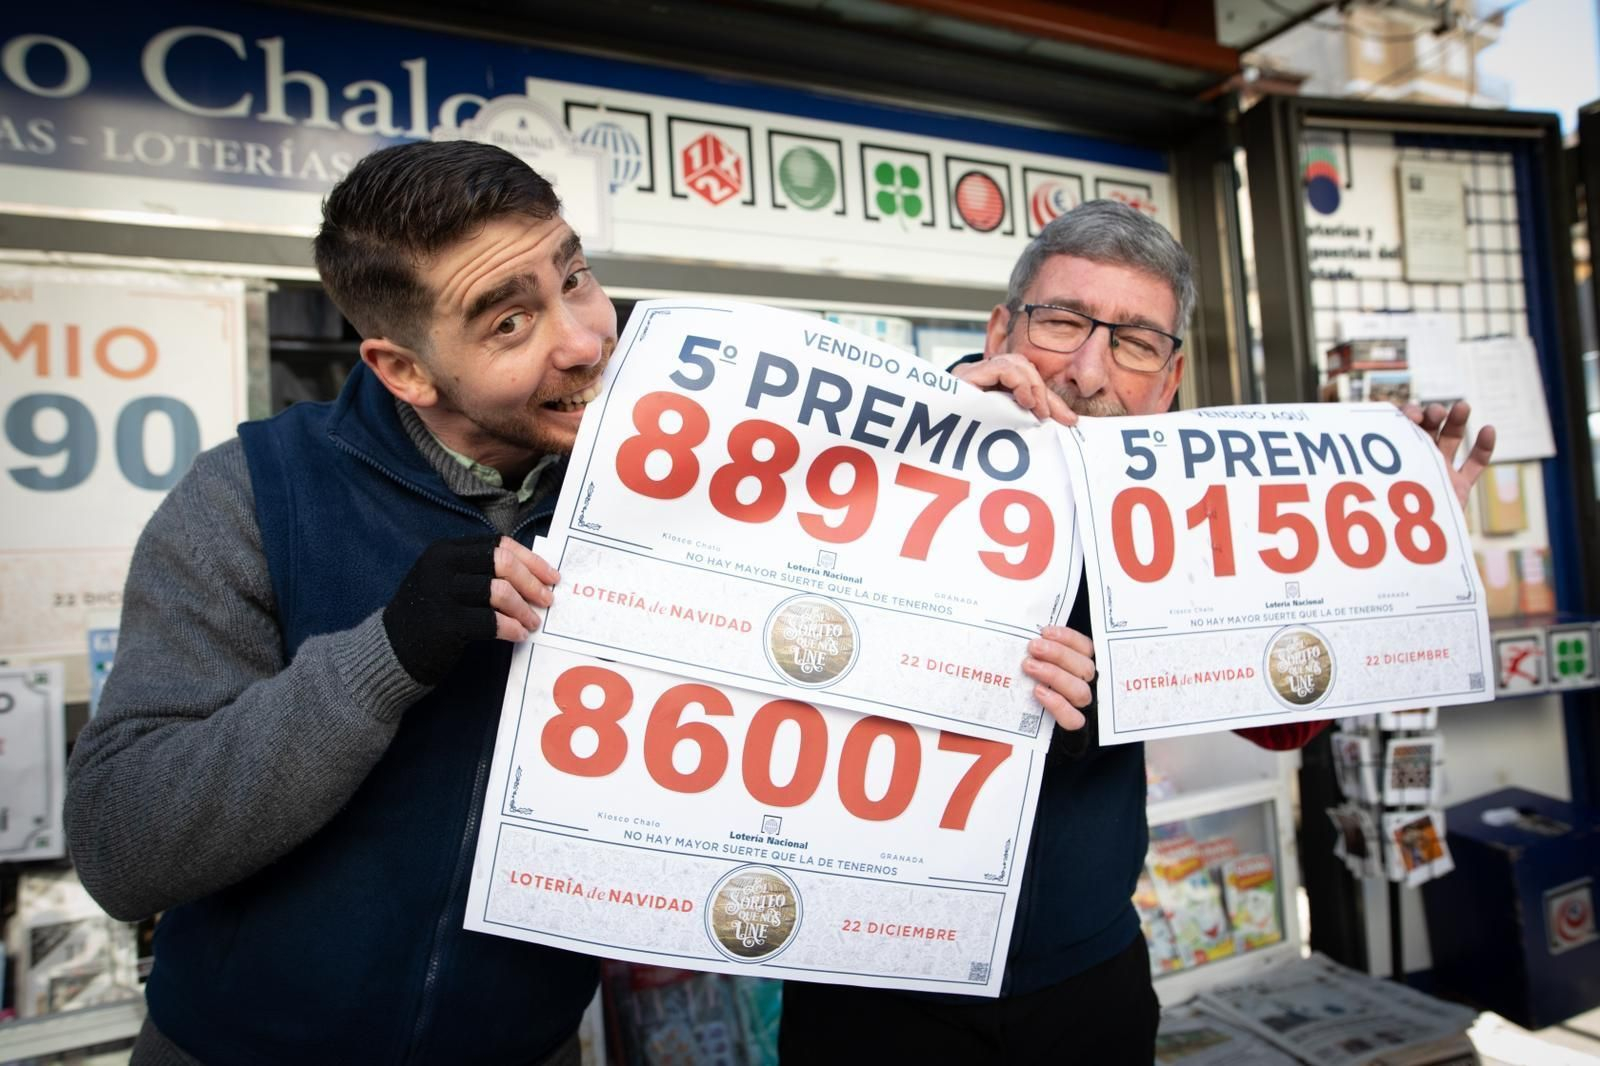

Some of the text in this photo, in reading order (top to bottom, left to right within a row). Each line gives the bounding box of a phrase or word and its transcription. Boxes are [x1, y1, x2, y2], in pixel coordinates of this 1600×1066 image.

[103, 125, 353, 182] LOTERÍAS
[804, 330, 960, 395] VENDIDO AQUÍ
[745, 351, 1031, 482] PREMIO
[5, 392, 200, 491] 90
[1178, 428, 1401, 478] PREMIO
[615, 391, 1056, 582] 88979
[661, 532, 692, 545] Kiosco
[1111, 480, 1447, 583] 01568
[686, 552, 953, 615] NO HAY MAYOR SUERTE QUE LA DE TENERNOS
[822, 568, 863, 584] Nacional
[572, 583, 752, 633] LOTERÍA de NAVIDAD
[934, 592, 979, 606] GRANADA
[1292, 597, 1324, 607] Nacional
[783, 618, 842, 641] SORTEO
[1190, 603, 1394, 627] NO HAY MAYOR SUERTE QUE LA DE TENERNOS
[791, 645, 826, 674] UNE
[900, 654, 1012, 688] 22 DICIEMBRE
[1366, 648, 1450, 667] 22 DICIEMBRE
[1125, 667, 1255, 691] LOTERÍA de NAVIDAD
[540, 665, 1013, 831] 86007
[597, 812, 661, 828] Kiosco Chalo
[624, 830, 898, 876] NO HAY MAYOR SUERTE QUE LA DE TENERNOS
[729, 831, 808, 850] Lotería Nacional
[880, 852, 924, 864] GRANADA
[510, 870, 694, 913] LOTERÍA de NAVIDAD
[725, 889, 786, 915] SORTEO
[731, 919, 769, 948] UNE
[842, 920, 957, 941] 22 DICIEMBRE
